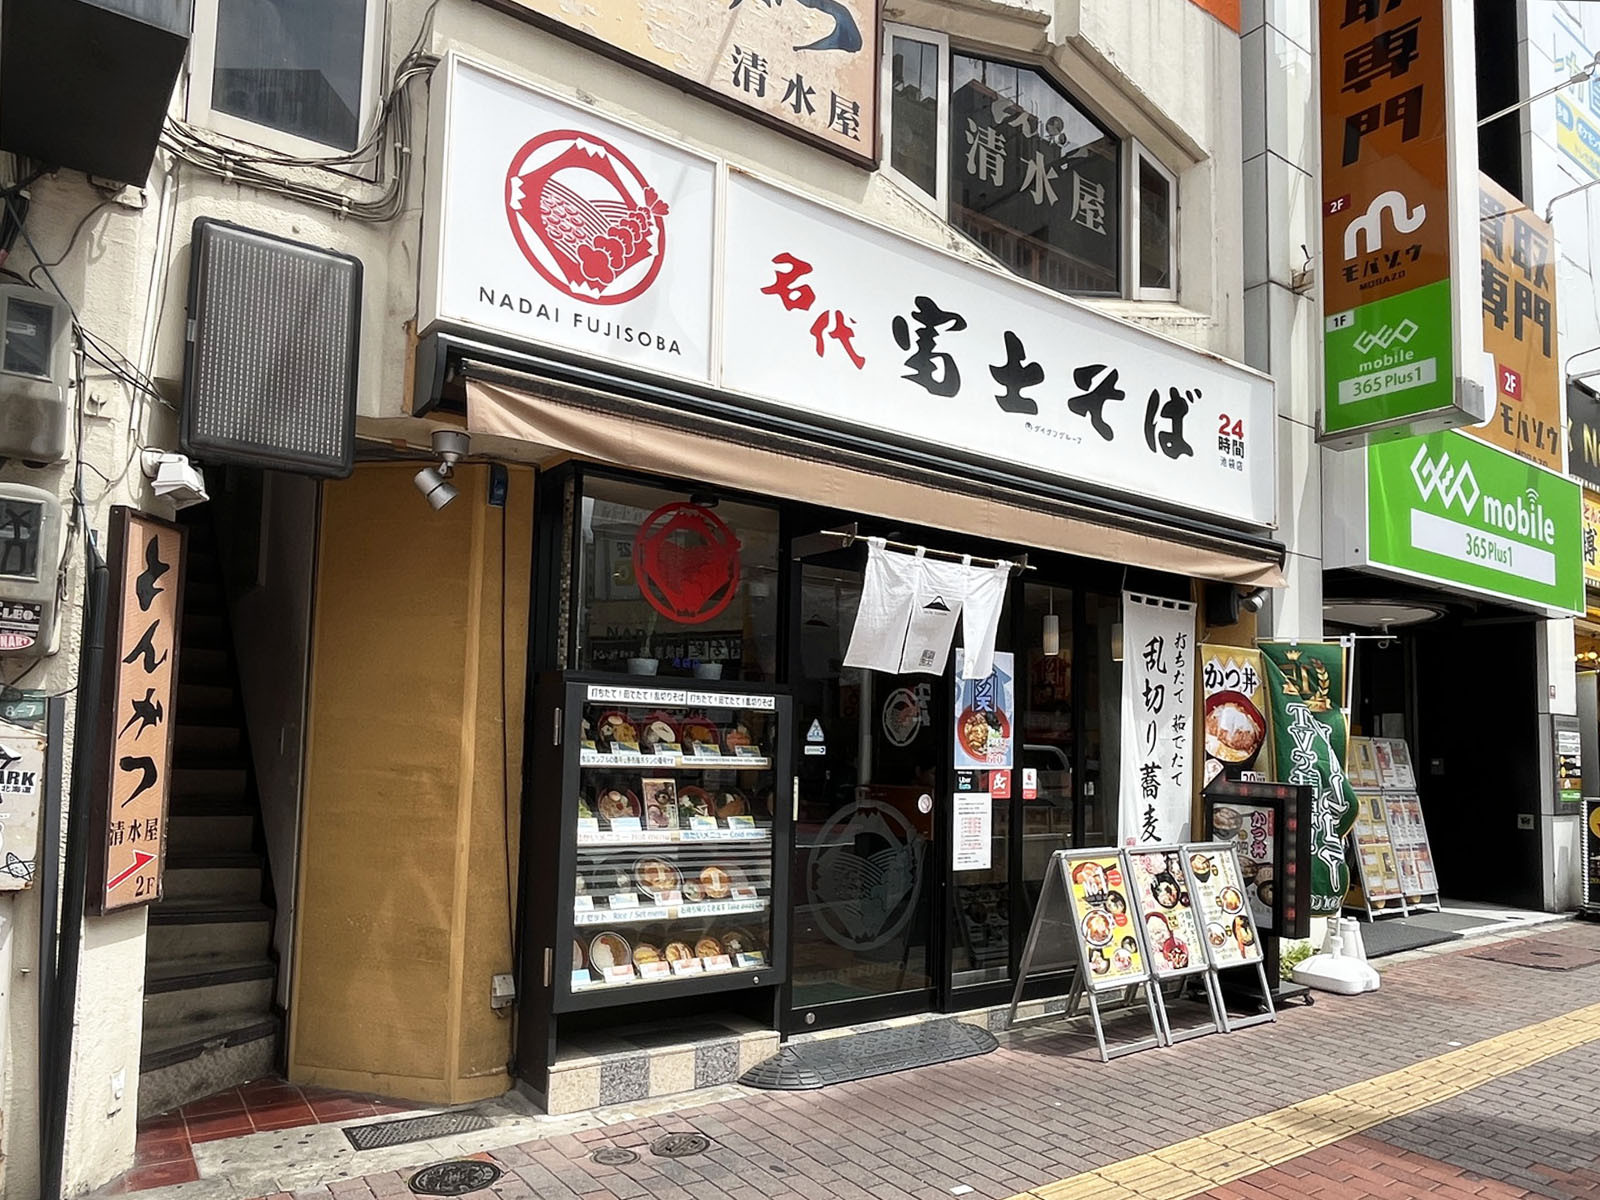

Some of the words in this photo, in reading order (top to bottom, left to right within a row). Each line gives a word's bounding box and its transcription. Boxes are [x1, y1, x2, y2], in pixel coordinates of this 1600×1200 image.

[731, 44, 861, 142] 清水屋
[965, 117, 1106, 235] 清水屋
[1330, 198, 1344, 213] 2F
[479, 286, 559, 323] NADAI
[573, 312, 682, 356] FUJISOBA
[1333, 315, 1346, 328] 1F
[760, 252, 866, 370] 名代
[892, 295, 1202, 460] 富士そば
[1360, 346, 1414, 372] mobile
[1503, 371, 1517, 393] 2F
[1218, 413, 1244, 440] 24
[1218, 436, 1244, 459] 時間
[1483, 494, 1555, 546] mobile
[118, 534, 170, 808] とんかつ
[1173, 632, 1187, 704] 打ちたて
[1204, 662, 1257, 694] かつ丼
[1140, 636, 1167, 842] 乱切り蕎麦
[109, 818, 158, 847] 清水屋
[135, 875, 156, 898] 2F
